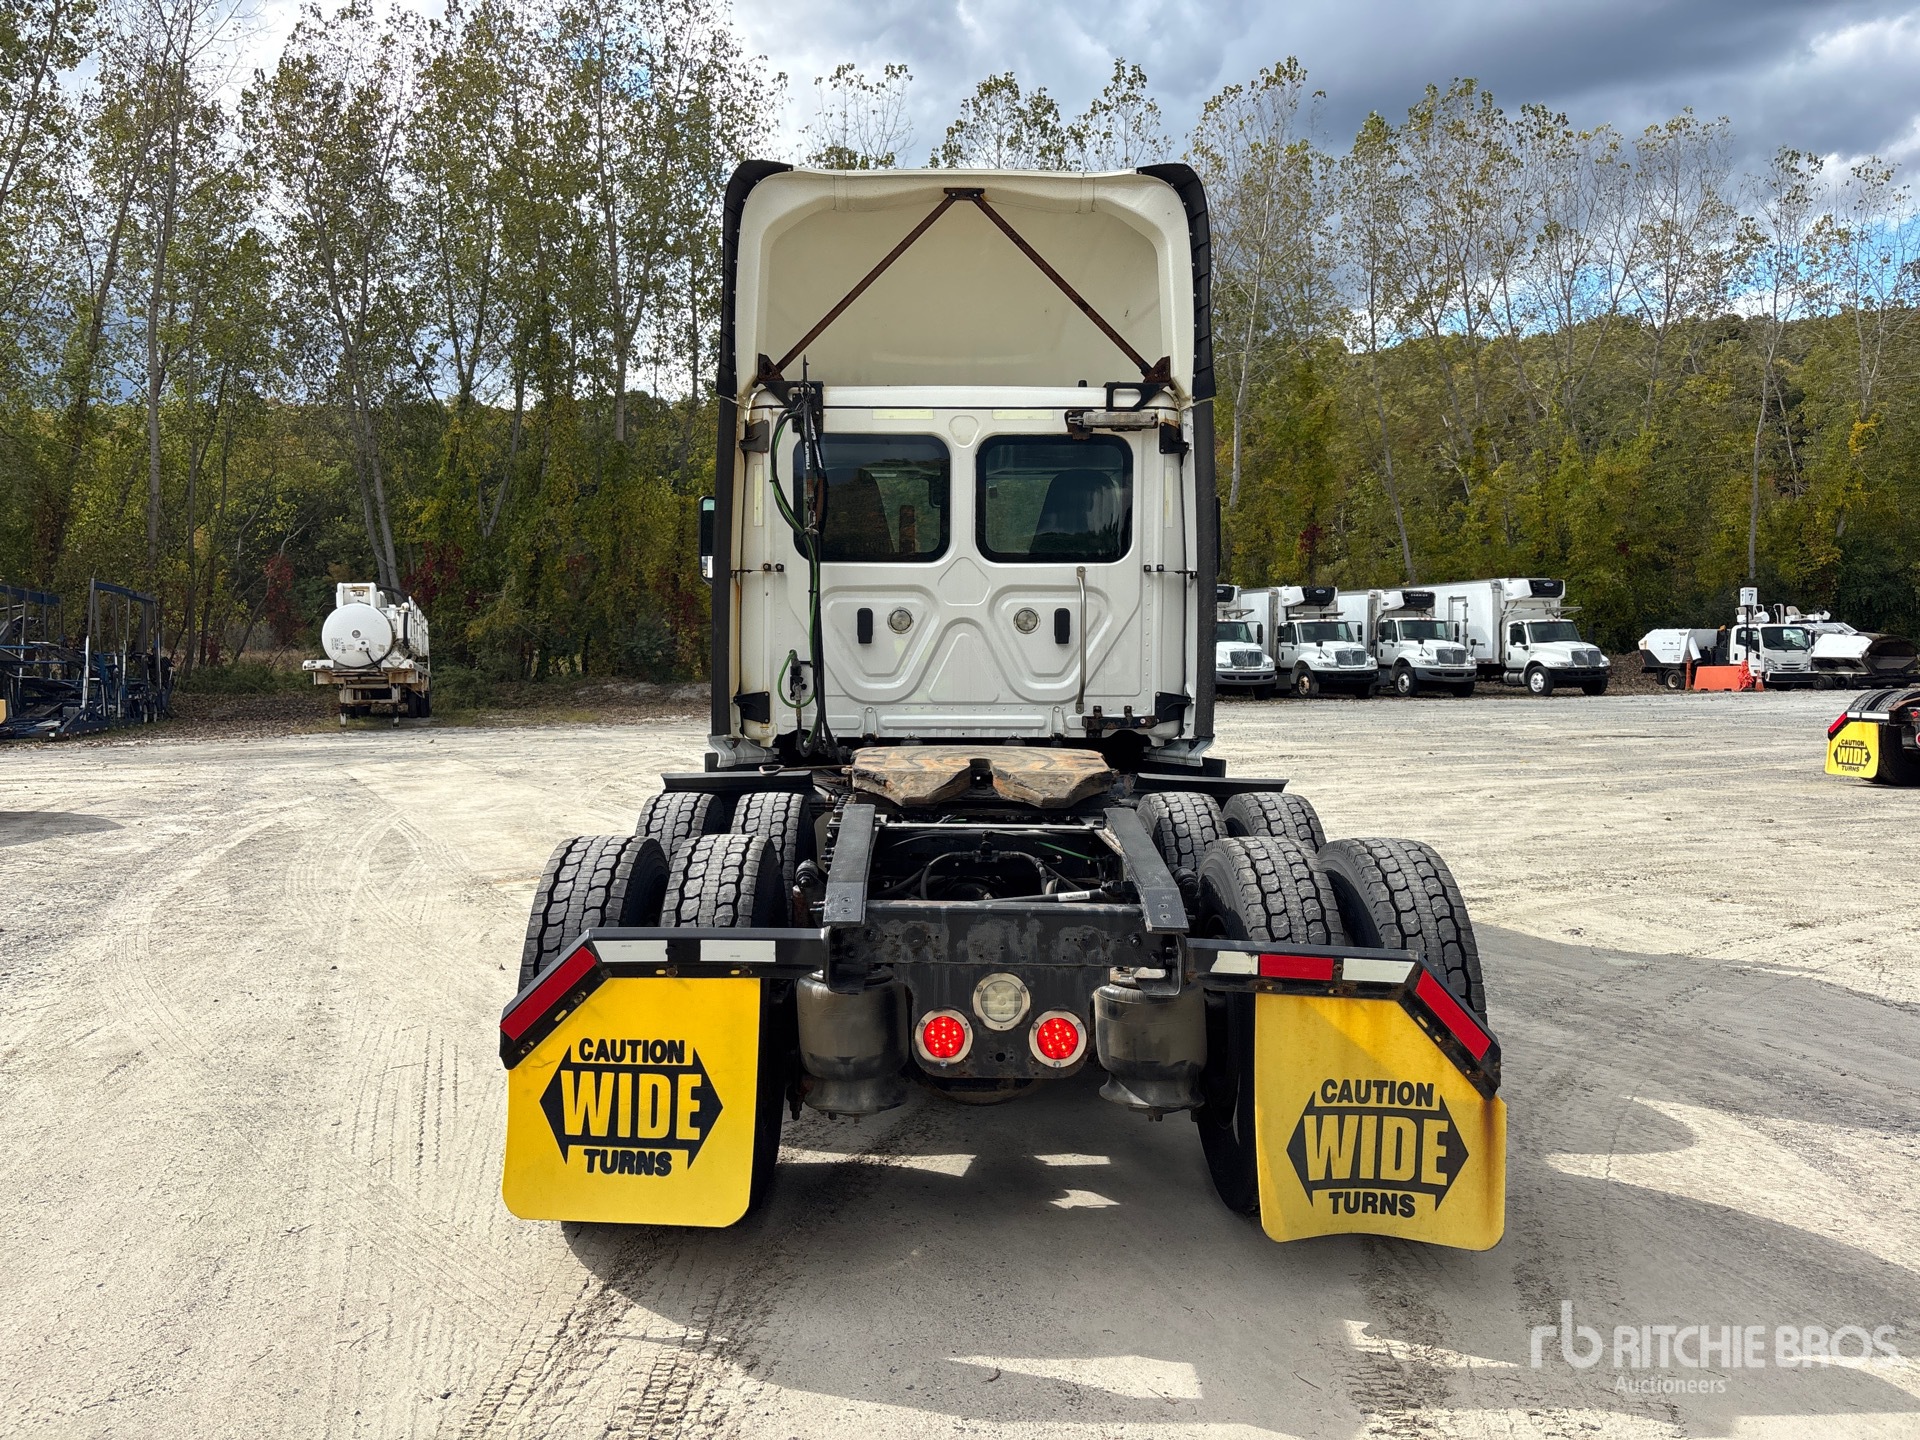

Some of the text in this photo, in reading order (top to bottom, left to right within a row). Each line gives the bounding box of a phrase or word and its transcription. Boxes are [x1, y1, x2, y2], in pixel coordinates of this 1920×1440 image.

[1748, 593, 1754, 602] 7
[1837, 747, 1867, 764] WIDE
[579, 1038, 685, 1064] CAUTION
[560, 1070, 702, 1140] WIDE
[1321, 1079, 1434, 1107] CAUTION
[584, 1148, 672, 1176] TURNS
[1304, 1114, 1449, 1186] WIDE
[1329, 1192, 1415, 1218] TURNS
